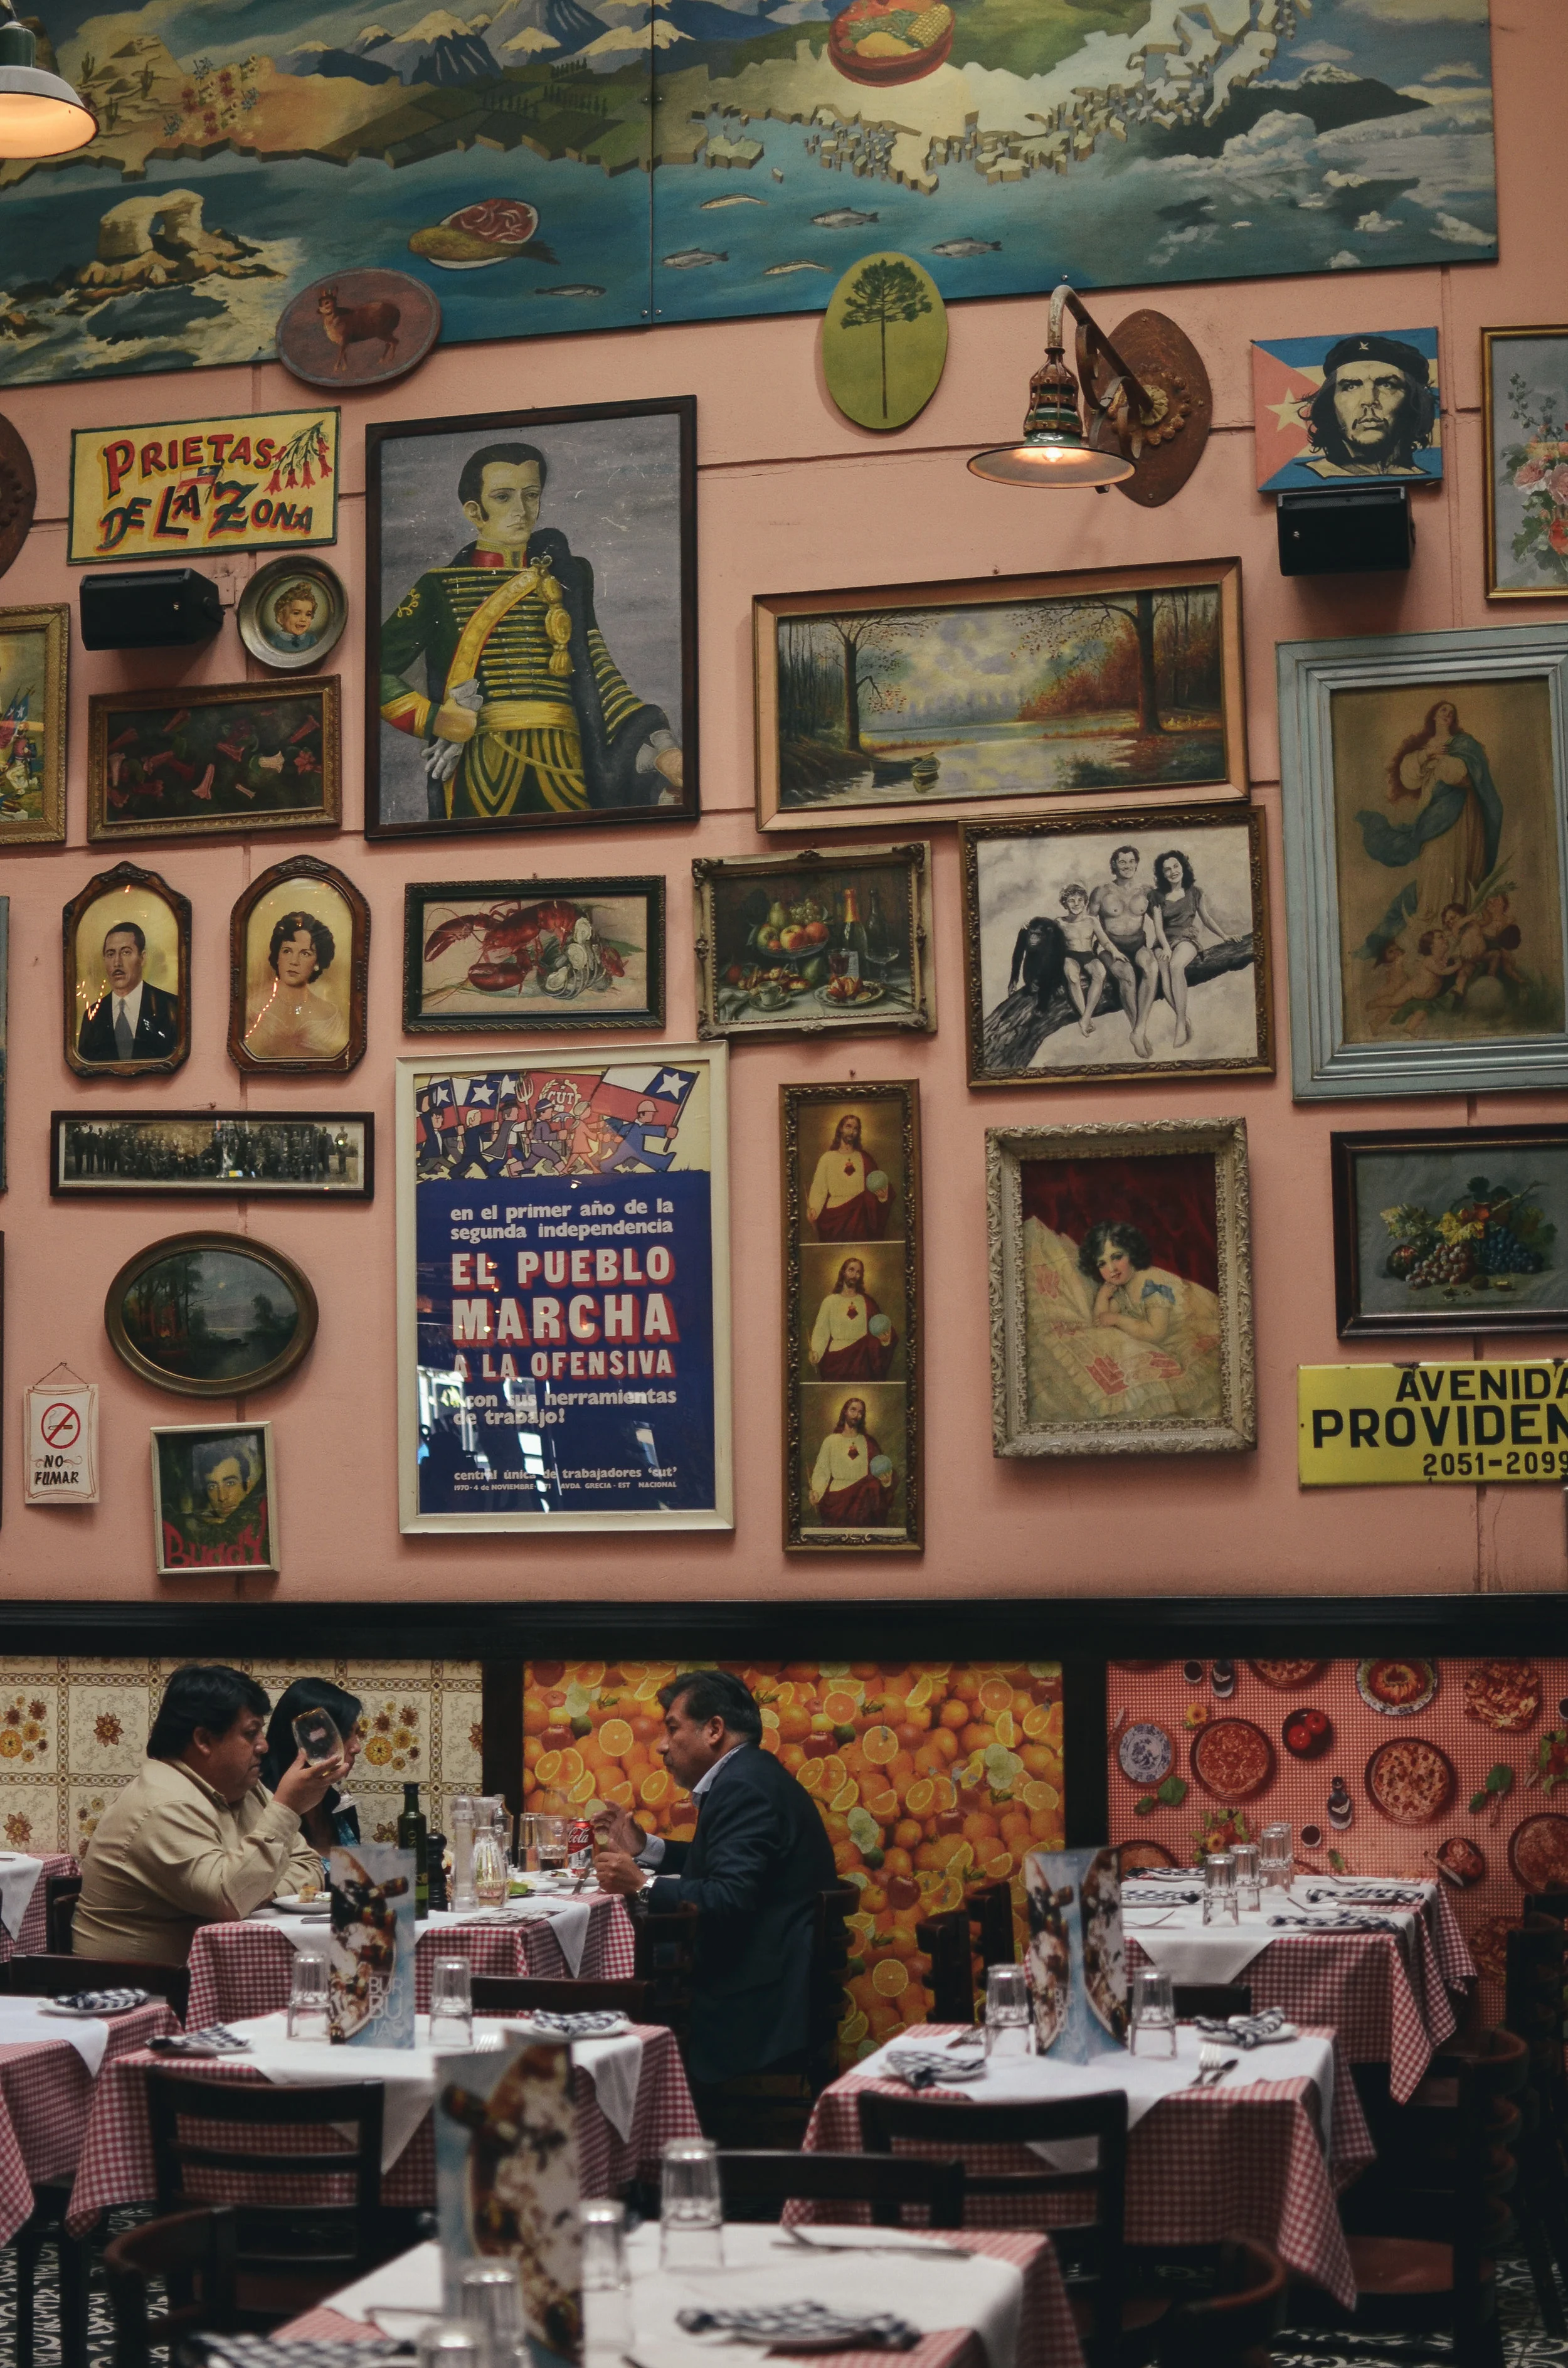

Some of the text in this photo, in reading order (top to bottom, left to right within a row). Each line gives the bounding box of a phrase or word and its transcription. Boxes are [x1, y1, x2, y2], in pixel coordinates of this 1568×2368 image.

[102, 433, 275, 500] PRIETAS
[96, 480, 313, 552] DE LA ZONA
[546, 1090, 575, 1105] CUT
[450, 1198, 674, 1223] en el primer año de la
[450, 1218, 674, 1244] segunda independencia
[452, 1246, 672, 1288] EL PUEBLO
[452, 1293, 674, 1342] MARCHA
[453, 1349, 673, 1379] A LA OFENSIVA
[506, 1394, 537, 1407] sus
[544, 1388, 677, 1406] herramientas
[453, 1408, 564, 1428] de trabajo!
[44, 1455, 64, 1468] NO
[34, 1470, 79, 1485] FUMAR
[543, 1468, 558, 1479] de
[561, 1467, 642, 1481] trabajadores
[567, 1826, 591, 1844] Cola
